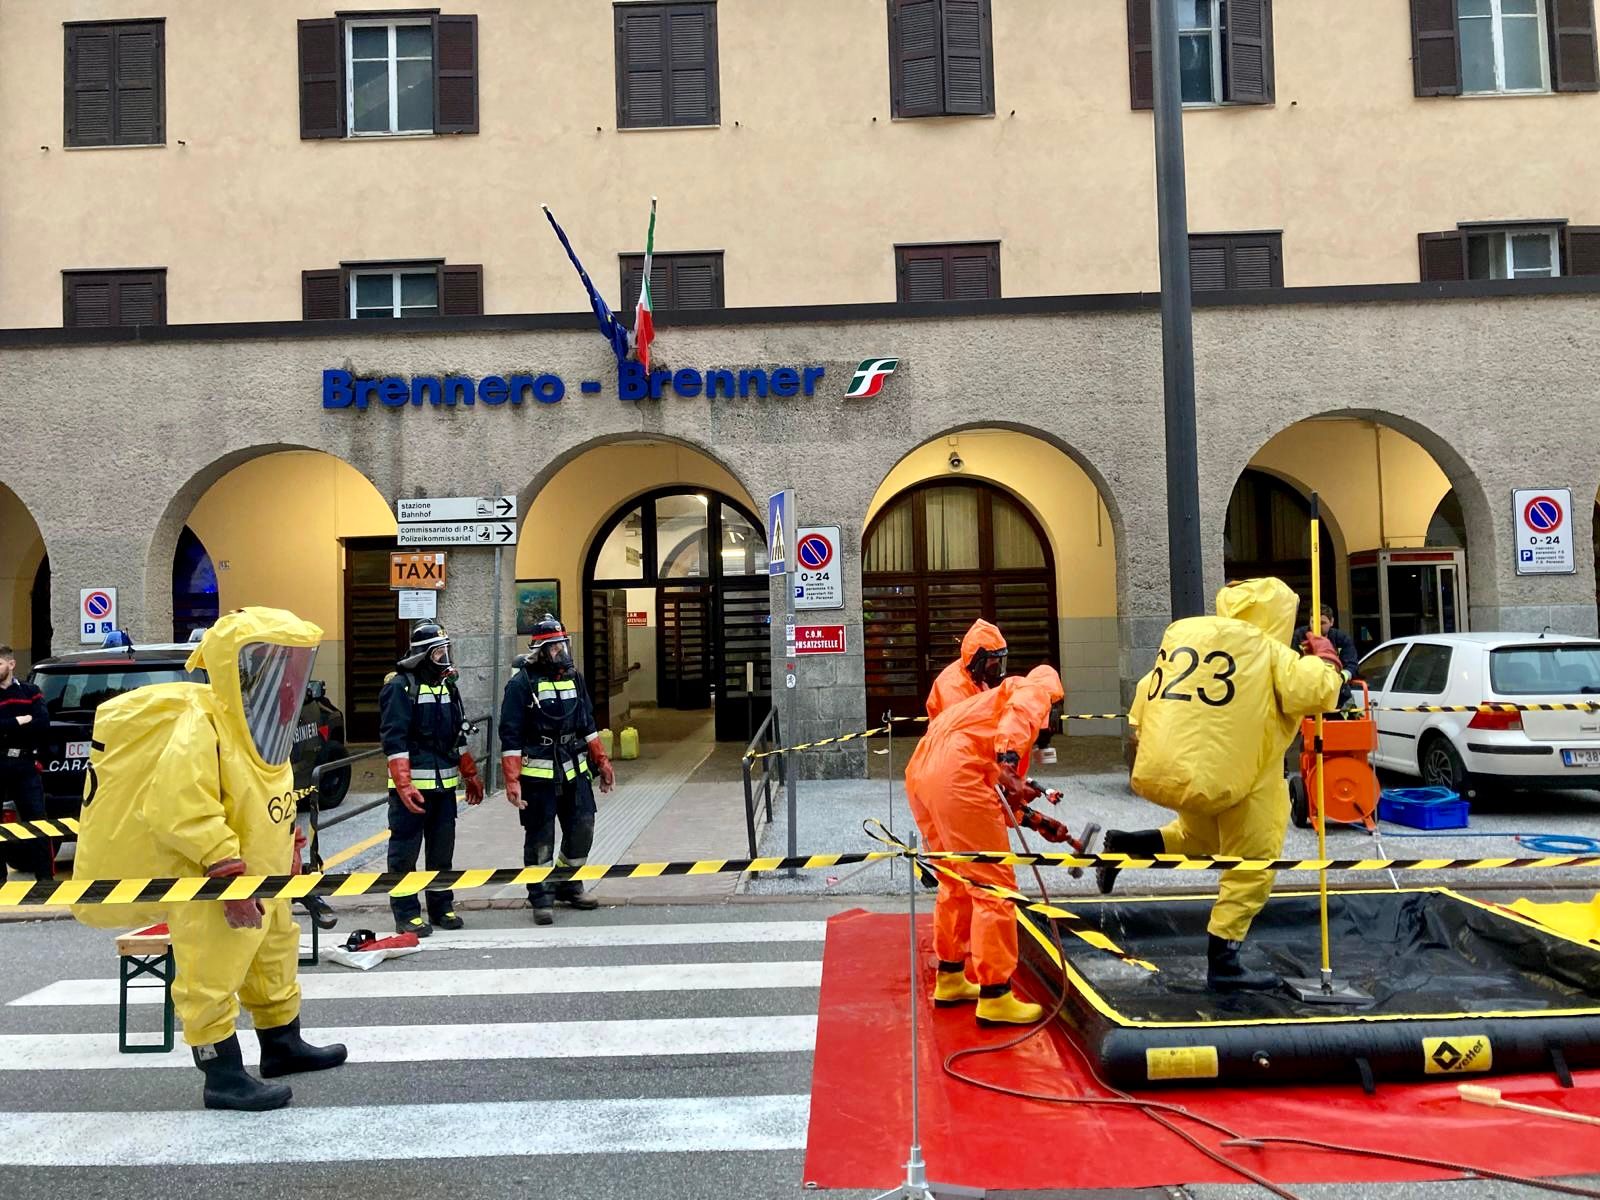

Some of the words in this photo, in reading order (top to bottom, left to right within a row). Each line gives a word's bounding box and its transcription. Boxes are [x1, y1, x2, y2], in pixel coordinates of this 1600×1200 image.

[322, 368, 565, 409] Brennero
[581, 381, 601, 393] -
[618, 361, 825, 400] Brenner
[400, 525, 453, 533] commissariato
[394, 562, 443, 579] TAXI
[1147, 646, 1236, 707] 623
[268, 791, 296, 824] 62
[1455, 1039, 1484, 1070] vetter
